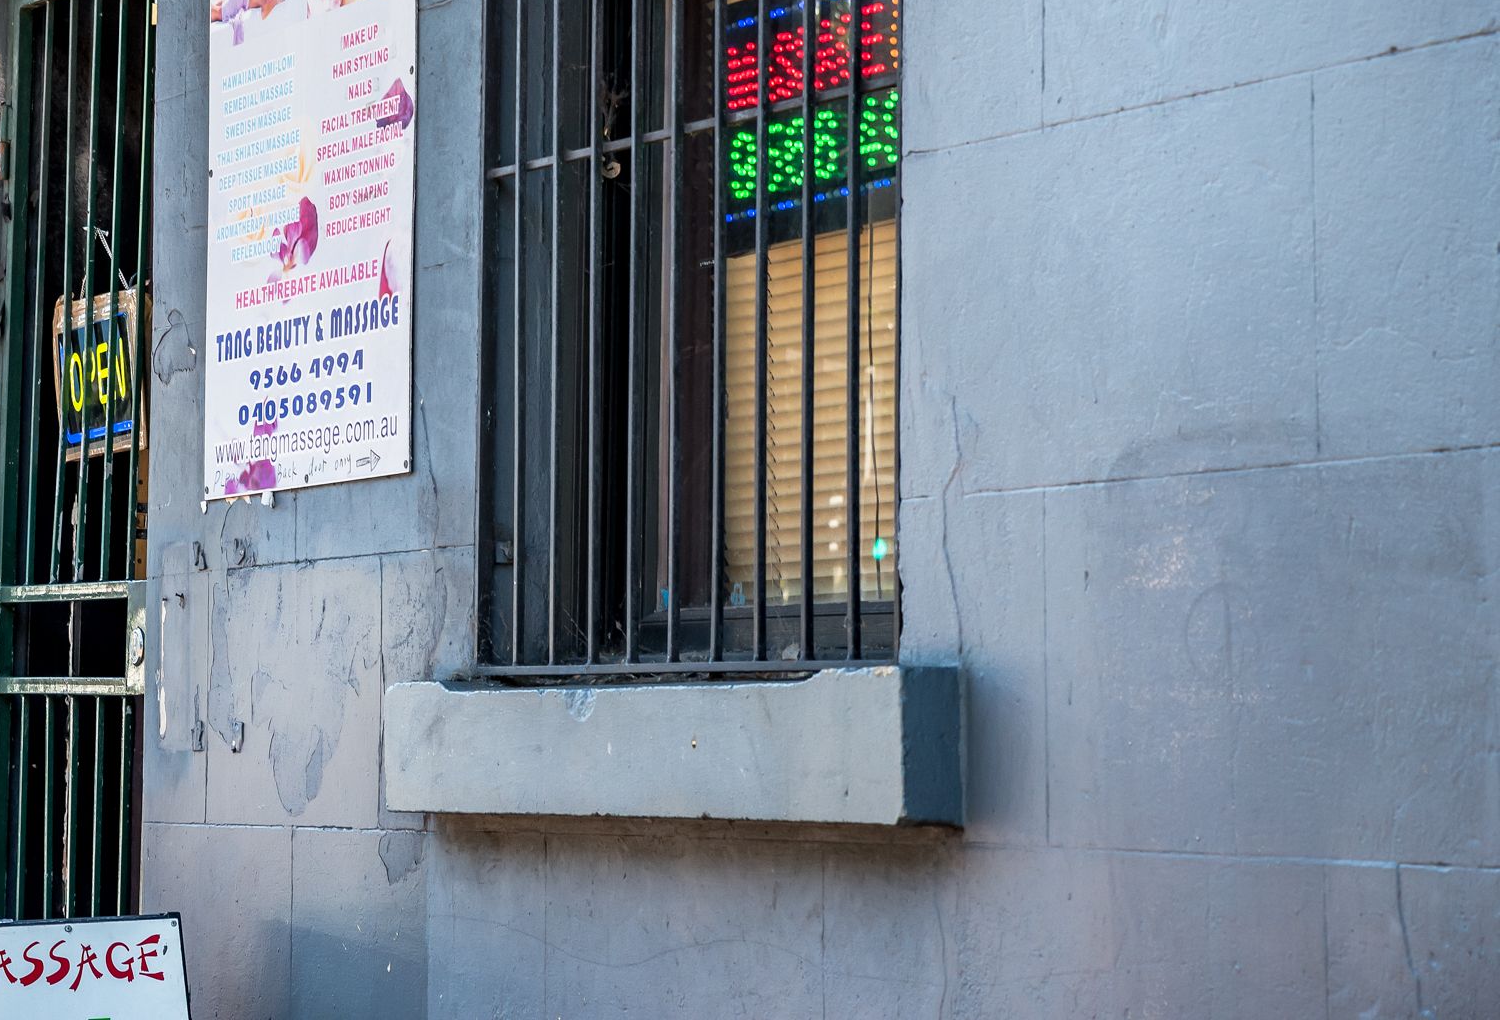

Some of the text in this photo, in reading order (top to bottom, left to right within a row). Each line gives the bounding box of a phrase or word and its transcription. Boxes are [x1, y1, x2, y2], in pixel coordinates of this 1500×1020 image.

[343, 24, 378, 49] MAKE UP
[222, 54, 295, 91] HAWAIIAN LOMI-LOMI
[332, 47, 389, 79] HAIR STYLING
[224, 80, 293, 115] REMEDIAL MASSAGE
[348, 79, 372, 100] NAILS
[226, 106, 291, 139] SWEDISH MASSAGE
[322, 98, 399, 134] FACIAL TREATMENT
[217, 132, 300, 166] THAI SHIATSU MASSAGE
[317, 123, 404, 162] SPECIAL MALE FACIAL
[219, 156, 297, 191] DEEP TISSUE MASSAGE
[324, 152, 395, 186] WAXING TONNING
[229, 185, 286, 212] SPORT MASSAGE
[330, 181, 388, 210] BODY SHAPING
[217, 207, 299, 241] AROMATHERAPY MASSAGE
[326, 207, 391, 237] REDUCE WEIGHT
[232, 238, 280, 261] REFLEXOLOGY
[236, 259, 378, 309] HEALTH REBATE AVAILABLE
[216, 295, 399, 363] TANG BEAUTY & MASSAGE
[250, 349, 364, 390] 9566 4994
[238, 382, 372, 426] 0405089591
[215, 415, 398, 463] www.tangmassage.com.au
